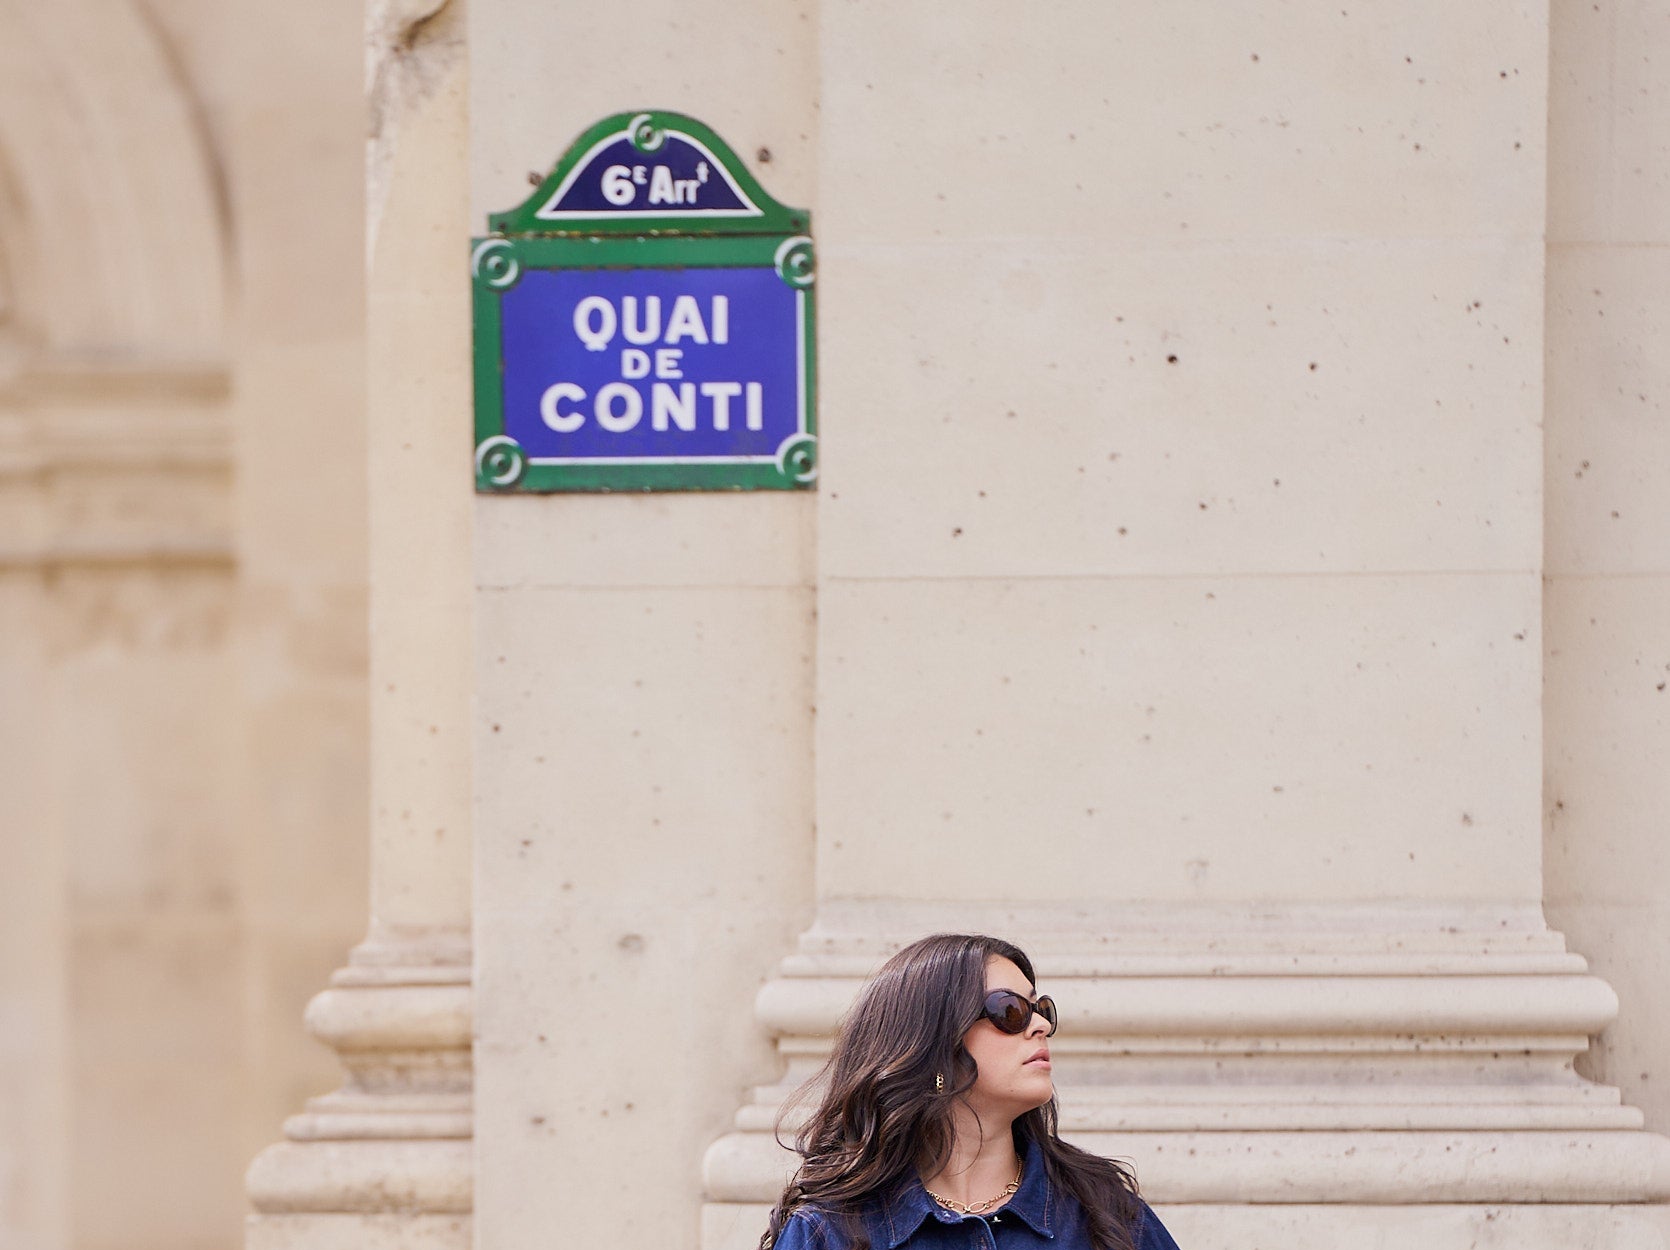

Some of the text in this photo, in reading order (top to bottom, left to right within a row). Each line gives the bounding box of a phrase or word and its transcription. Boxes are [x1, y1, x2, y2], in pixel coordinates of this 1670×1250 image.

[648, 161, 709, 205] Arrt
[573, 295, 729, 351] QUAI
[621, 349, 683, 380] DE
[539, 381, 763, 433] CONTI
